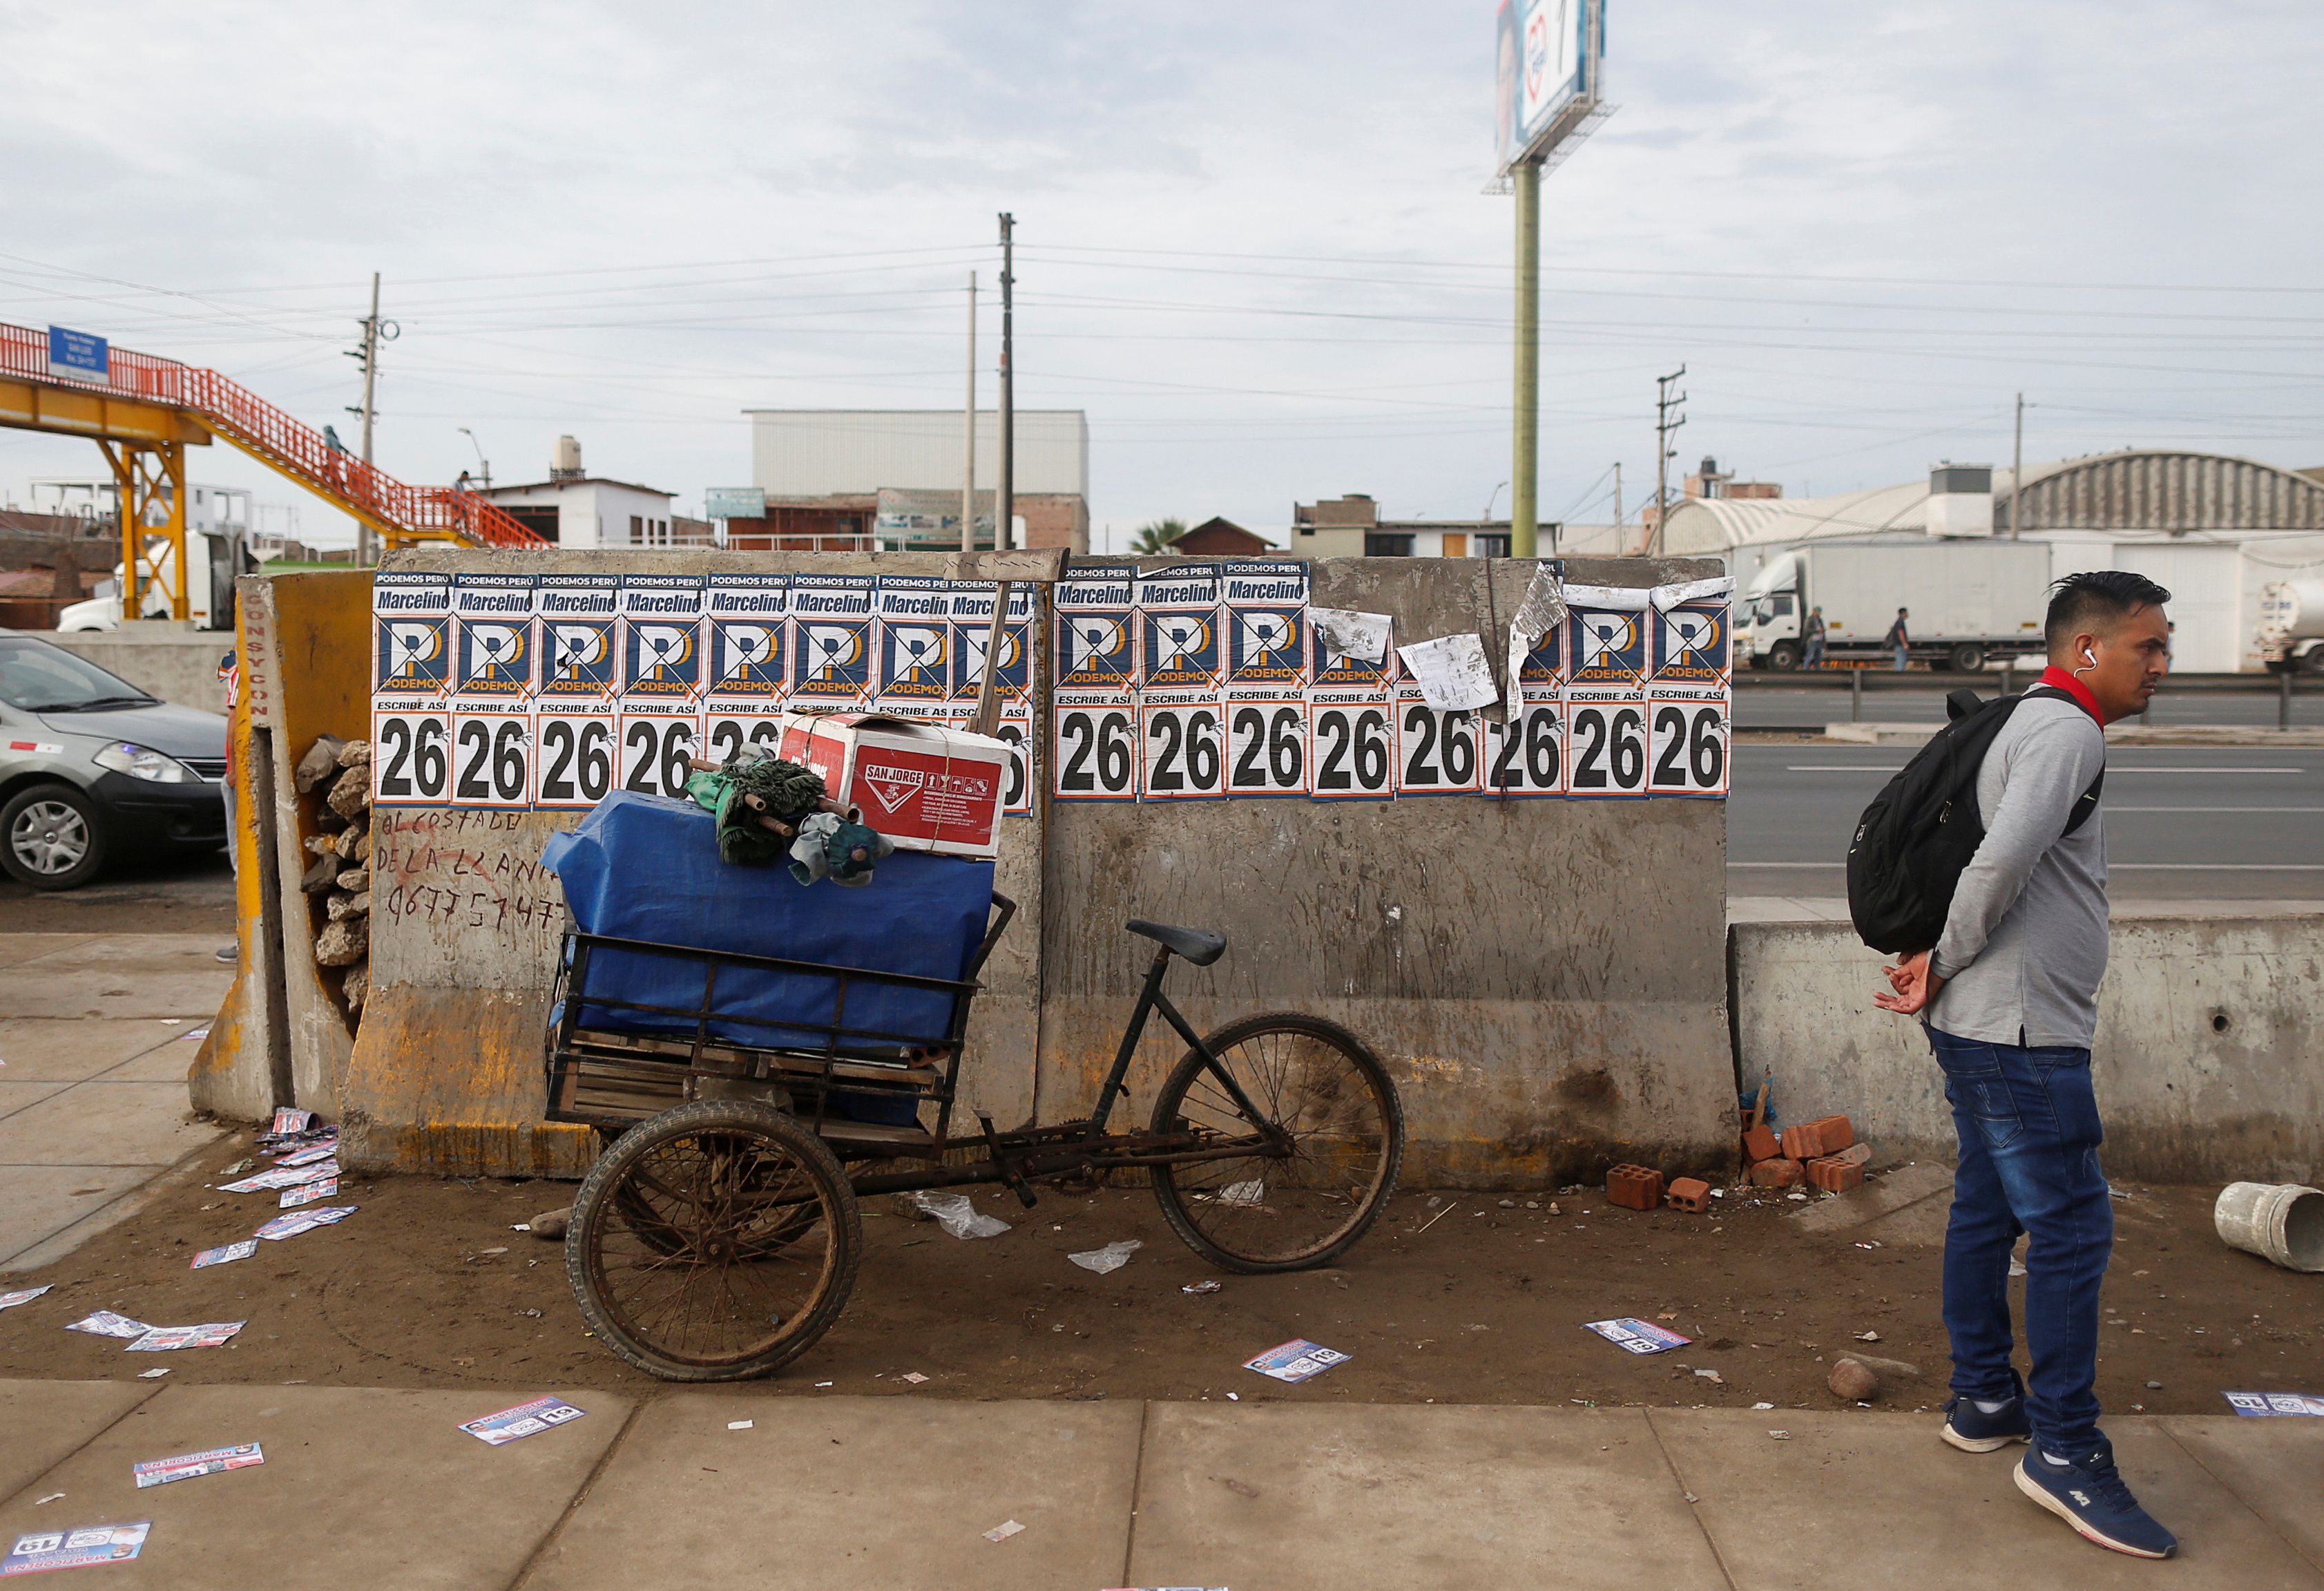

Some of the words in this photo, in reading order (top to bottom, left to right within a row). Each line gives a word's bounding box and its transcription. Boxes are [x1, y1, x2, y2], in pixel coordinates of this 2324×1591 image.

[1227, 564, 1276, 573] PODEMOS
[377, 575, 423, 584] PODEMOS
[424, 575, 448, 583] PERÚ
[459, 577, 506, 586] PODEMOS
[508, 576, 533, 586] PERÚ
[541, 577, 590, 586] PODEMOS
[592, 576, 617, 587] PERÚ
[626, 577, 674, 586] PODEMOS
[676, 577, 702, 587] PERÚ
[711, 577, 760, 585] PODEMOS
[761, 577, 787, 586] PERÚ
[796, 577, 844, 586] PODEMOS
[846, 577, 872, 587] PERÚ
[882, 579, 932, 588] PODEMOS
[883, 595, 948, 614] Marcelin
[1059, 696, 1107, 704] ESCRIBE
[1111, 695, 1131, 704] ASÍ
[1145, 695, 1195, 704] ESCRIBE
[1199, 694, 1217, 703] ASÍ
[1284, 690, 1302, 699] ASÍ
[1314, 694, 1363, 703] ESCRIBE
[1367, 692, 1387, 702] ASÍ
[1571, 692, 1620, 701] ESCRIBE
[1623, 692, 1643, 701] ASÍ
[1651, 690, 1702, 698] ESCRIBE
[1705, 691, 1724, 699] ASÍ
[378, 702, 425, 710] ESCRIBE
[428, 701, 446, 709] ASÍ
[457, 703, 505, 712] ESCRIBE
[508, 703, 528, 712] ASÍ
[541, 704, 589, 713] ESCRIBE
[592, 703, 611, 713] ASÍ
[624, 704, 673, 713] ESCRIBE
[676, 703, 696, 714] ASÍ
[709, 704, 758, 713] ESCRIBE
[762, 703, 782, 713] ASÍ
[879, 707, 928, 716] ESCRIBE
[931, 707, 947, 717] AS
[1006, 707, 1026, 718] ASÍ
[1150, 710, 1220, 790] 26
[1233, 707, 1302, 788] 26
[1318, 710, 1387, 789] 26
[1404, 705, 1475, 785] 26
[1490, 707, 1559, 788] 26
[1573, 709, 1643, 788] 26
[1653, 707, 1723, 788] 26
[1062, 712, 1131, 791] 26
[381, 718, 446, 797] 26
[457, 720, 525, 801] 26
[541, 721, 610, 801] 26
[626, 721, 692, 800] 26
[867, 766, 888, 779] SAN
[890, 769, 922, 783] JORGE
[377, 847, 399, 872] DE
[1315, 1351, 1336, 1360] 19
[545, 1409, 573, 1420] 19
[142, 1450, 232, 1470] MARTICORENA
[19, 1539, 57, 1552] 19
[6, 1555, 107, 1572] MARTICORENA
